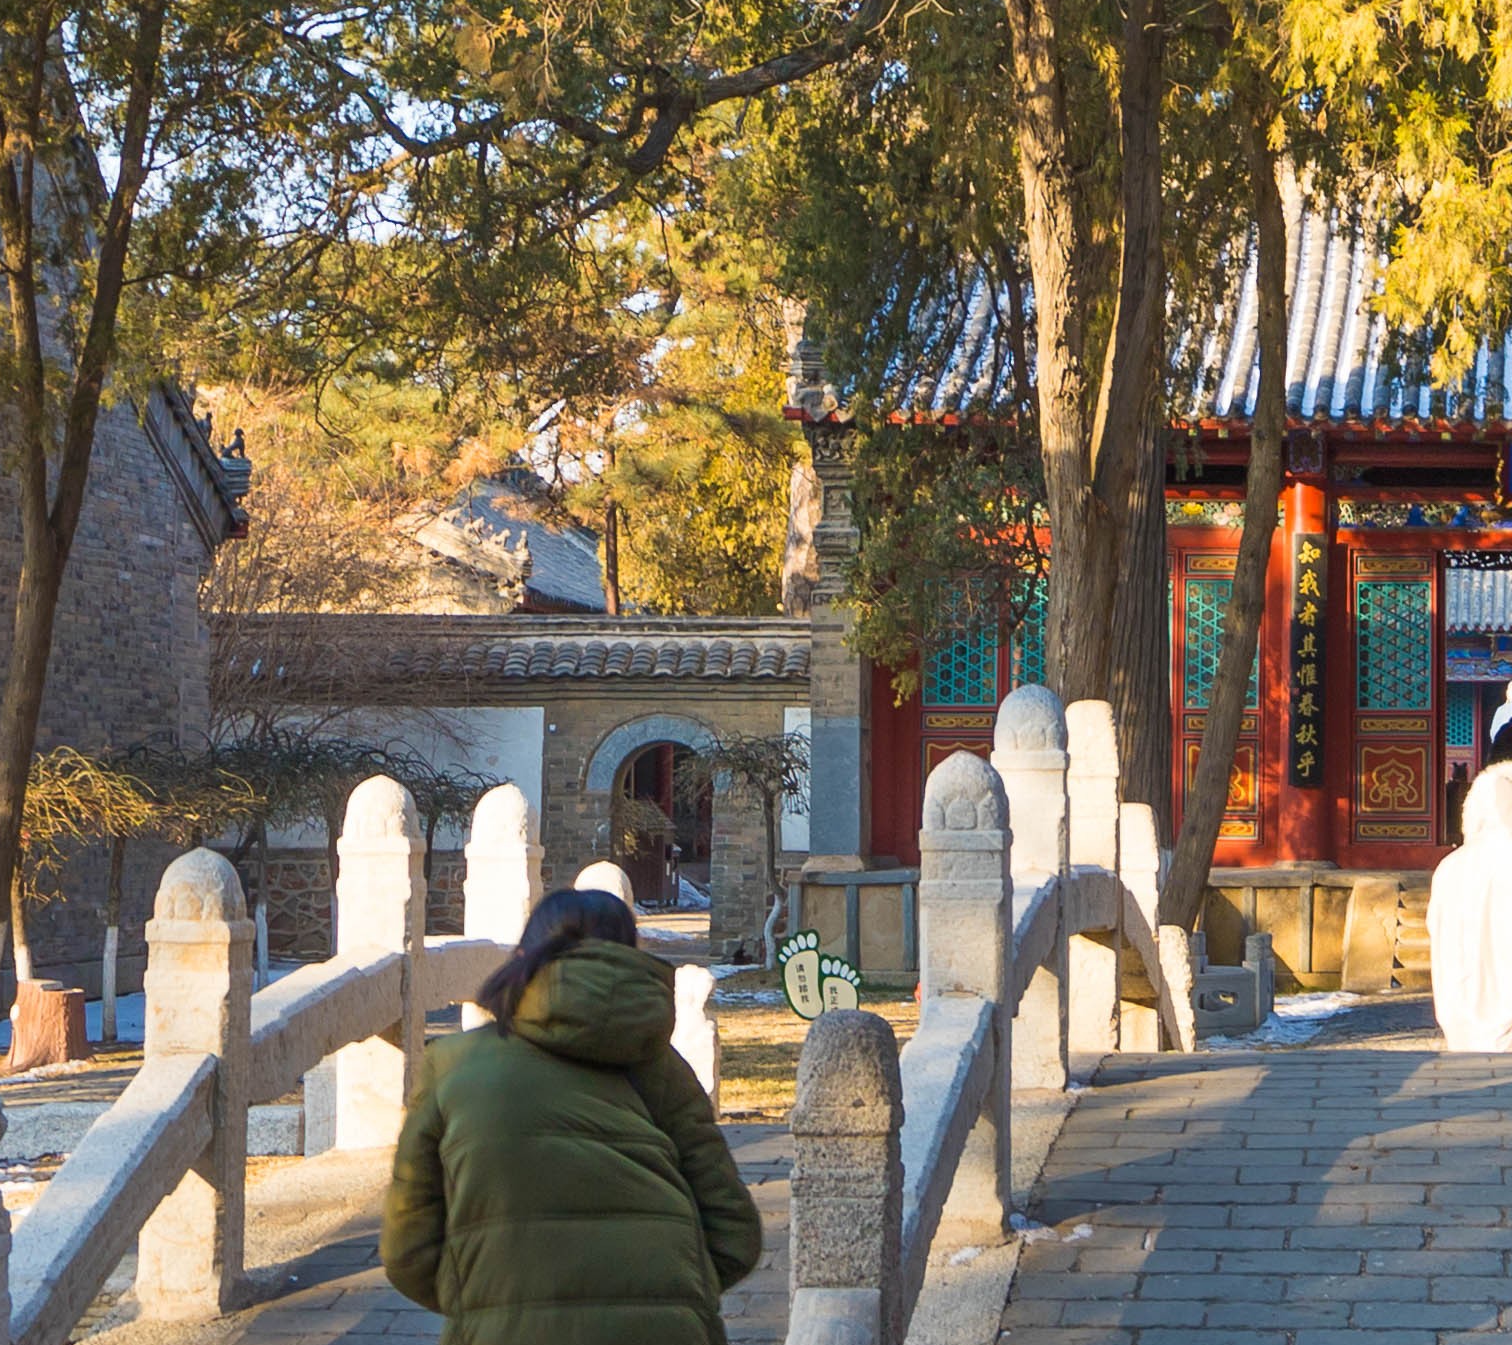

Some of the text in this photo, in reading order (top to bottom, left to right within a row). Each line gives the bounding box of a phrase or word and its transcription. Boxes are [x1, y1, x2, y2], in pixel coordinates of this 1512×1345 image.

[1296, 541, 1322, 777] 知我者其惟春秋乎
